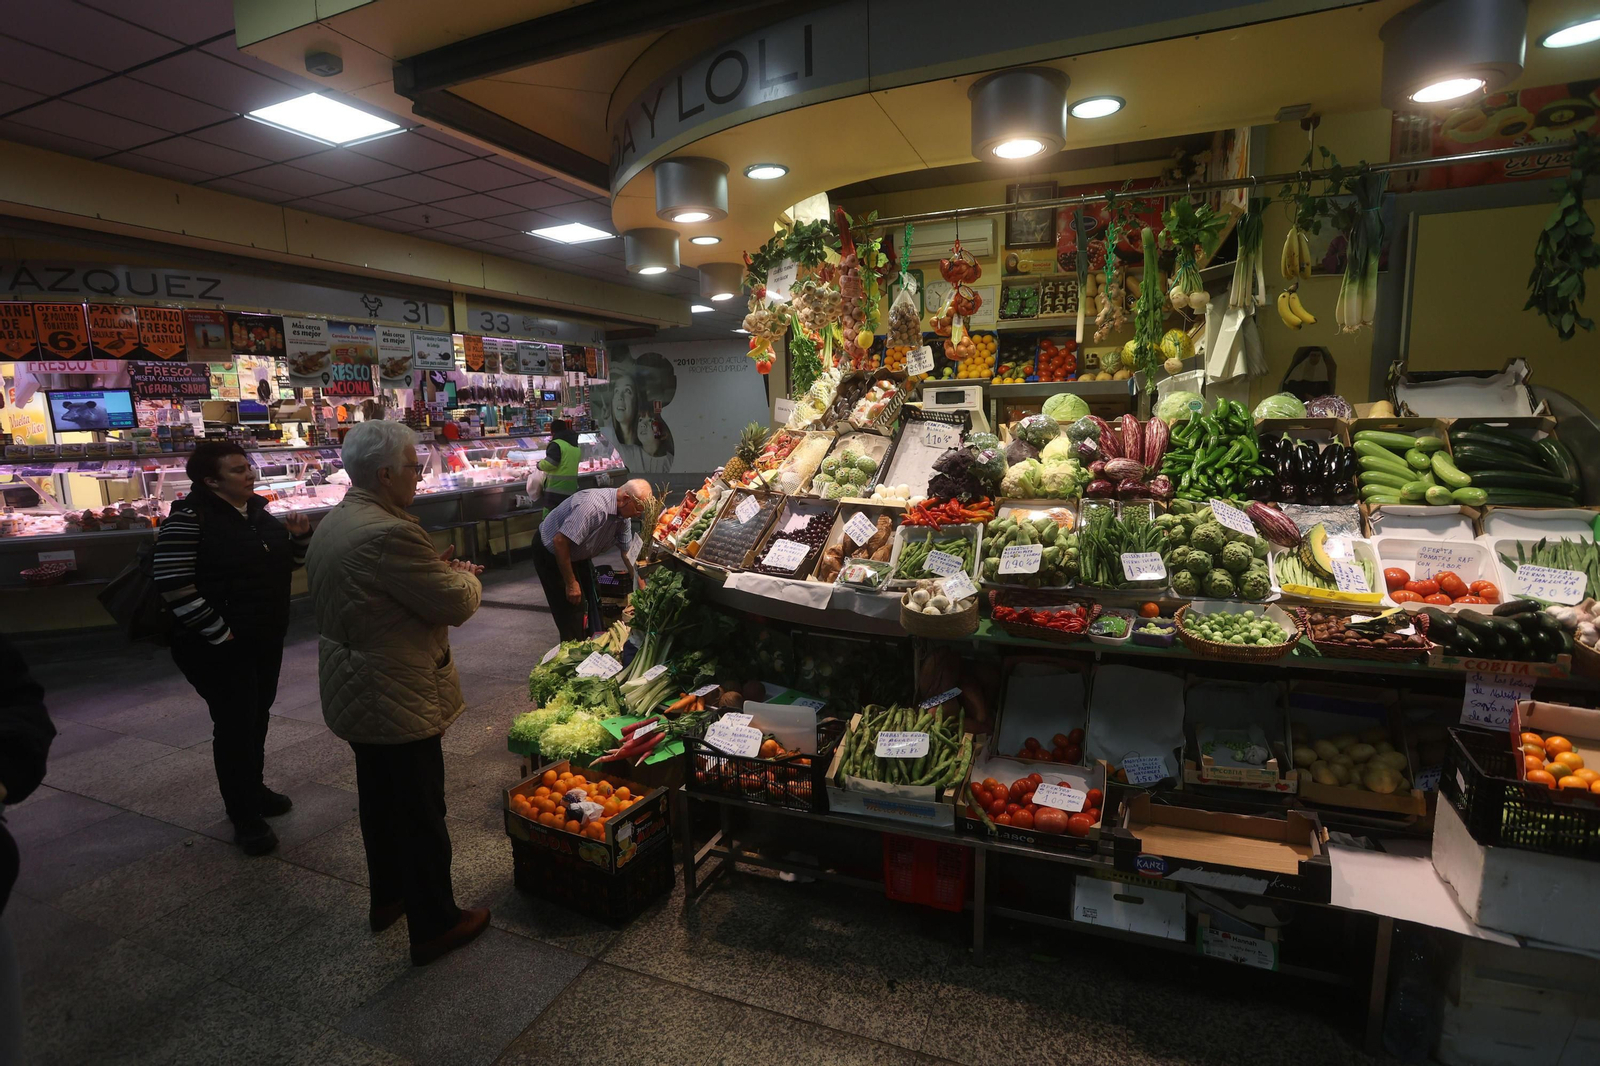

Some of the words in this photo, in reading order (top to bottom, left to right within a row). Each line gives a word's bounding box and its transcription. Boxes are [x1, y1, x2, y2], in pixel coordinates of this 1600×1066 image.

[0, 262, 224, 300] ÁZQUEZ
[37, 305, 80, 313] OFERTA
[89, 304, 135, 315] PATO
[402, 301, 430, 325] 31
[42, 313, 49, 322] 2
[140, 310, 180, 322] LECHAZO
[2, 318, 20, 330] DE
[43, 322, 79, 331] TOMATEROS
[292, 321, 305, 330] Más
[480, 311, 510, 334] 33
[140, 323, 183, 334] FRESCO
[301, 330, 322, 339] mejor
[48, 331, 77, 352] 6
[390, 337, 406, 345] mejor
[144, 366, 192, 377] FRESCO
[332, 363, 371, 381] RESCO
[1421, 546, 1453, 555] OFERTA
[1419, 552, 1452, 562] TOMATES
[1518, 570, 1546, 578] TIERNA
[1464, 659, 1531, 675] COBITA
